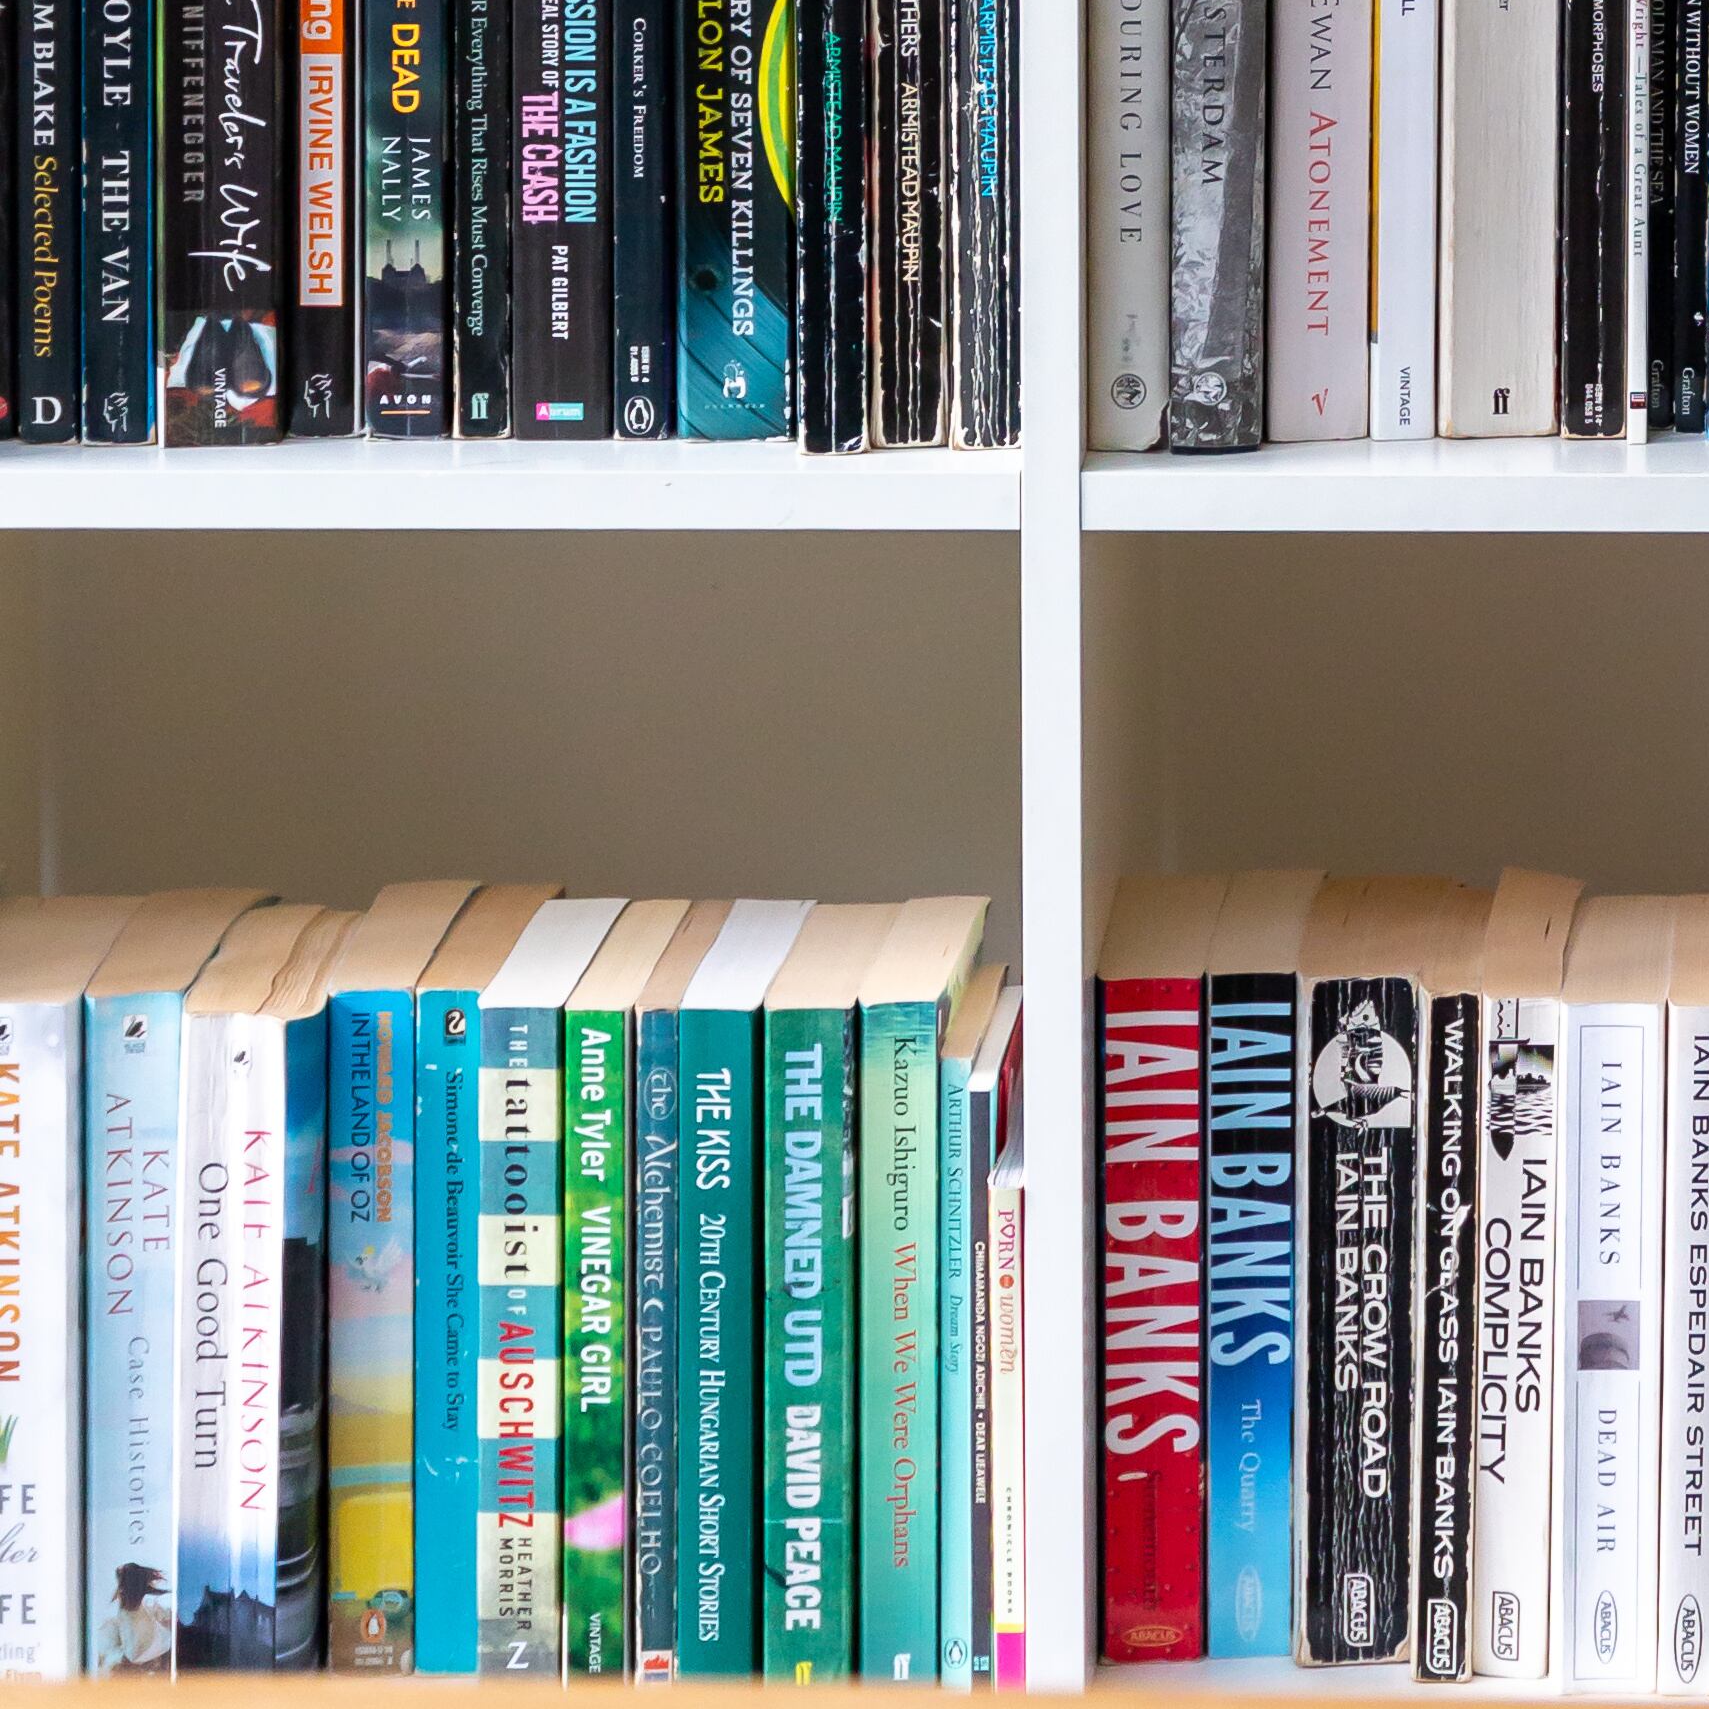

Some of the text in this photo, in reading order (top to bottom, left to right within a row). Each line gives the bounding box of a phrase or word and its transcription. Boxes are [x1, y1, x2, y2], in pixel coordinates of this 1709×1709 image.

[33, 41, 55, 146] BLAKE
[466, 17, 488, 109] Everything
[471, 115, 488, 152] That
[471, 158, 488, 201] Rises
[33, 155, 57, 260] Selected
[471, 206, 488, 249] Must
[33, 269, 56, 357] Poems
[466, 255, 488, 336] Converge
[551, 245, 569, 339] PAT GILBERT
[576, 1029, 612, 1412] Anne Tyler VINEGAR GIRL
[1689, 1116, 1709, 1232] BANKS
[195, 1162, 226, 1471] One Good Turn
[1687, 1244, 1708, 1412] ESPEDAIR
[127, 1336, 150, 1546] Case Histories
[1685, 1425, 1705, 1556] STREET
[588, 1612, 601, 1673] VINTAGE
[1680, 1607, 1697, 1672] ABACUS
